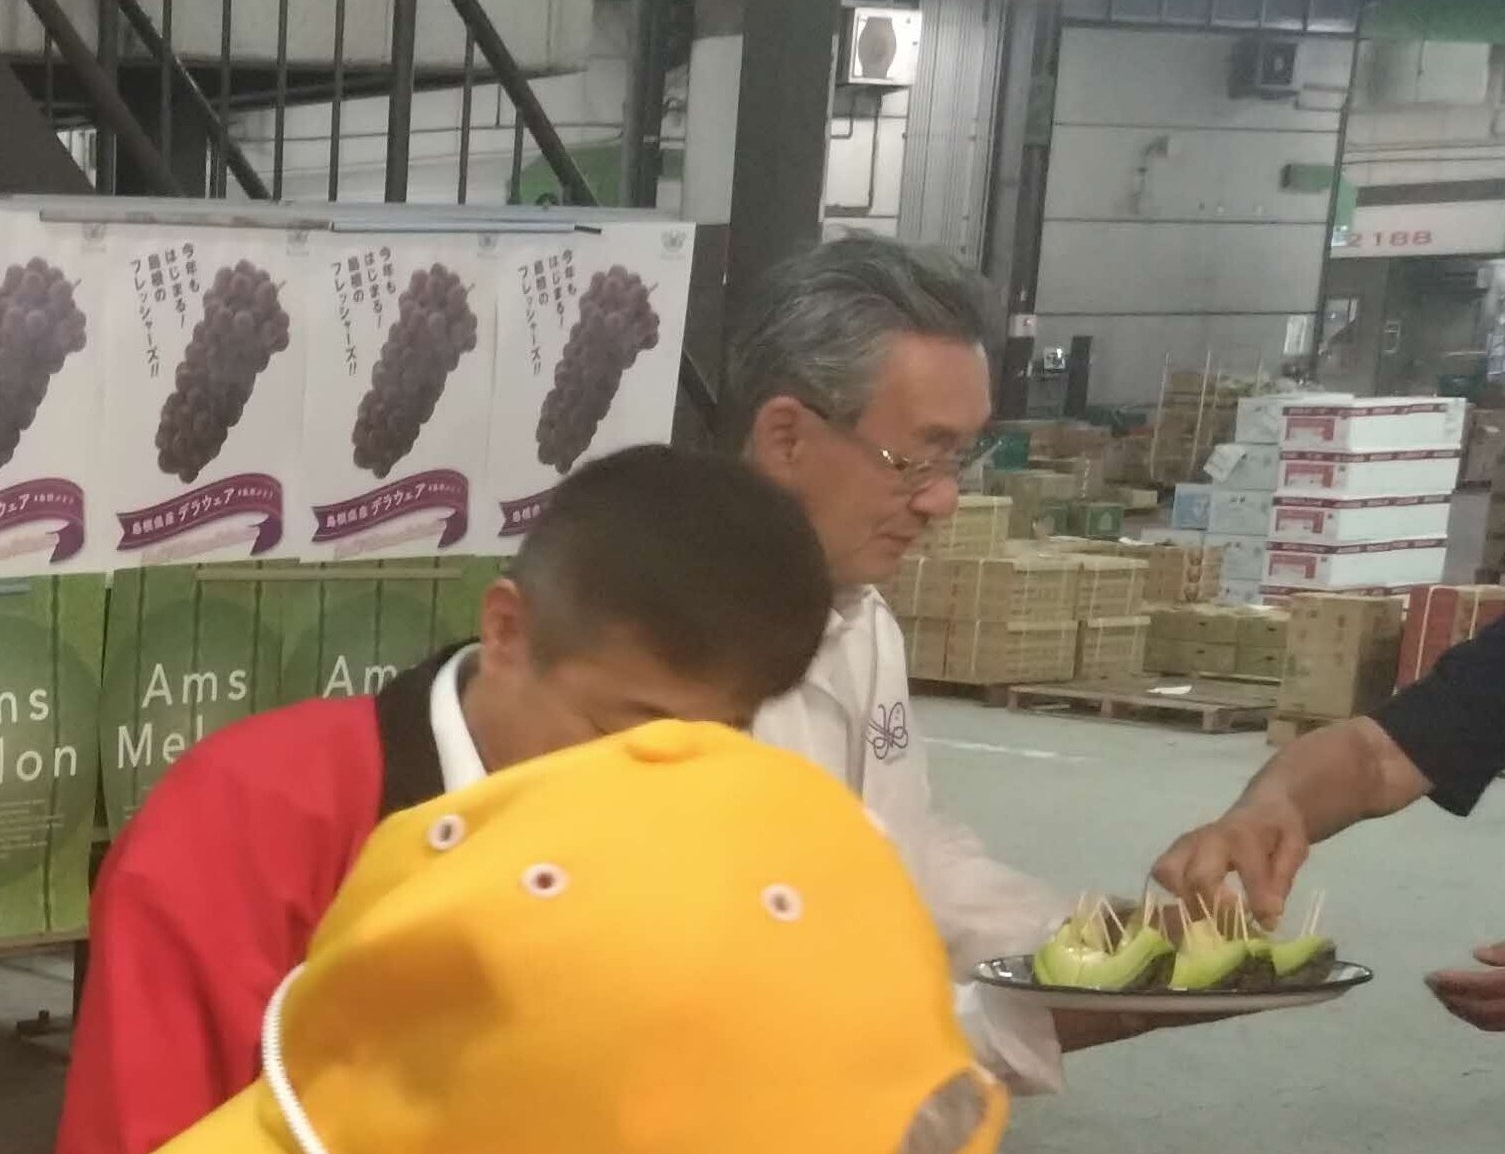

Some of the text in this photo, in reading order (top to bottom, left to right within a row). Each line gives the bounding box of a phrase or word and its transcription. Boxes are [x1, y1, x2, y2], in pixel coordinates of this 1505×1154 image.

[141, 663, 248, 708] Ams
[322, 655, 399, 698] Am
[117, 715, 204, 769] Mel
